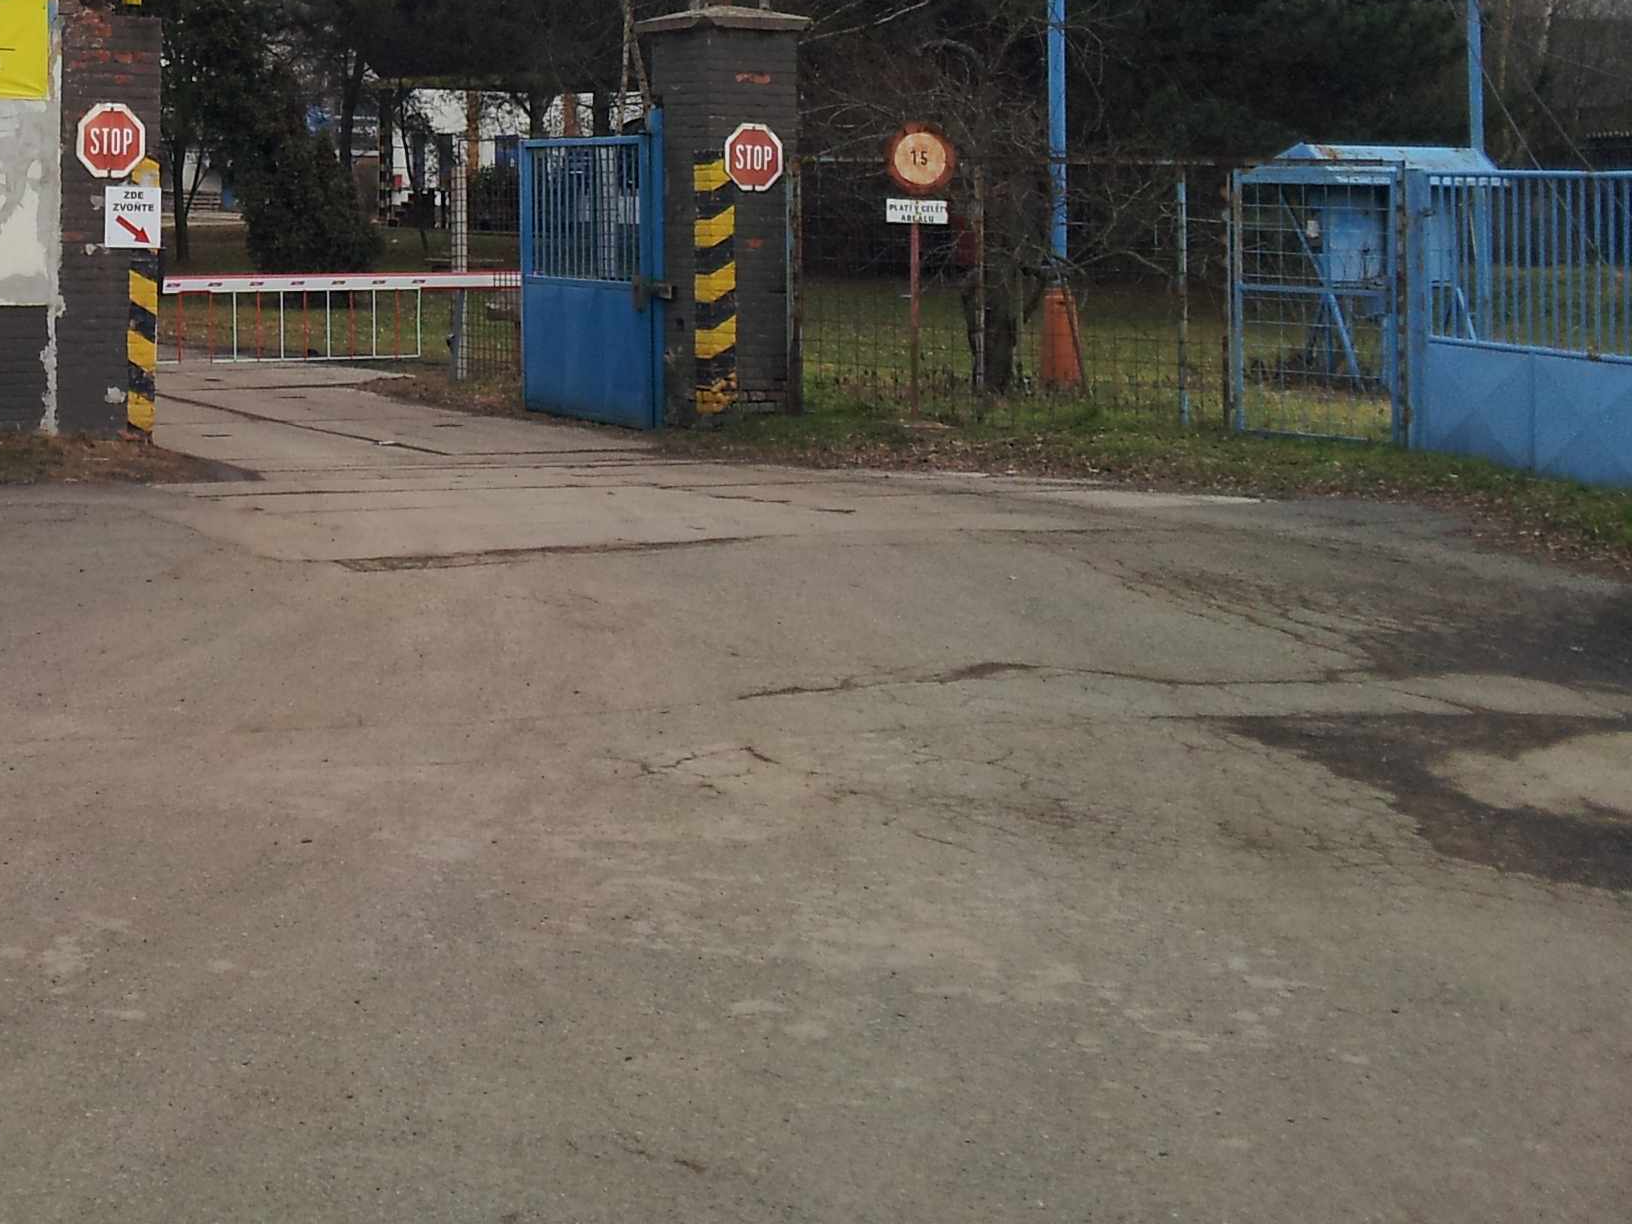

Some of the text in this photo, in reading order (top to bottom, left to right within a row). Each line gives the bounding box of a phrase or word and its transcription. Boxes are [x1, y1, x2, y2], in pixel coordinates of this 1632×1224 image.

[90, 127, 133, 155] STOP
[735, 143, 773, 171] STOP
[123, 191, 144, 200] ZDE
[112, 203, 155, 212] ZVONTE
